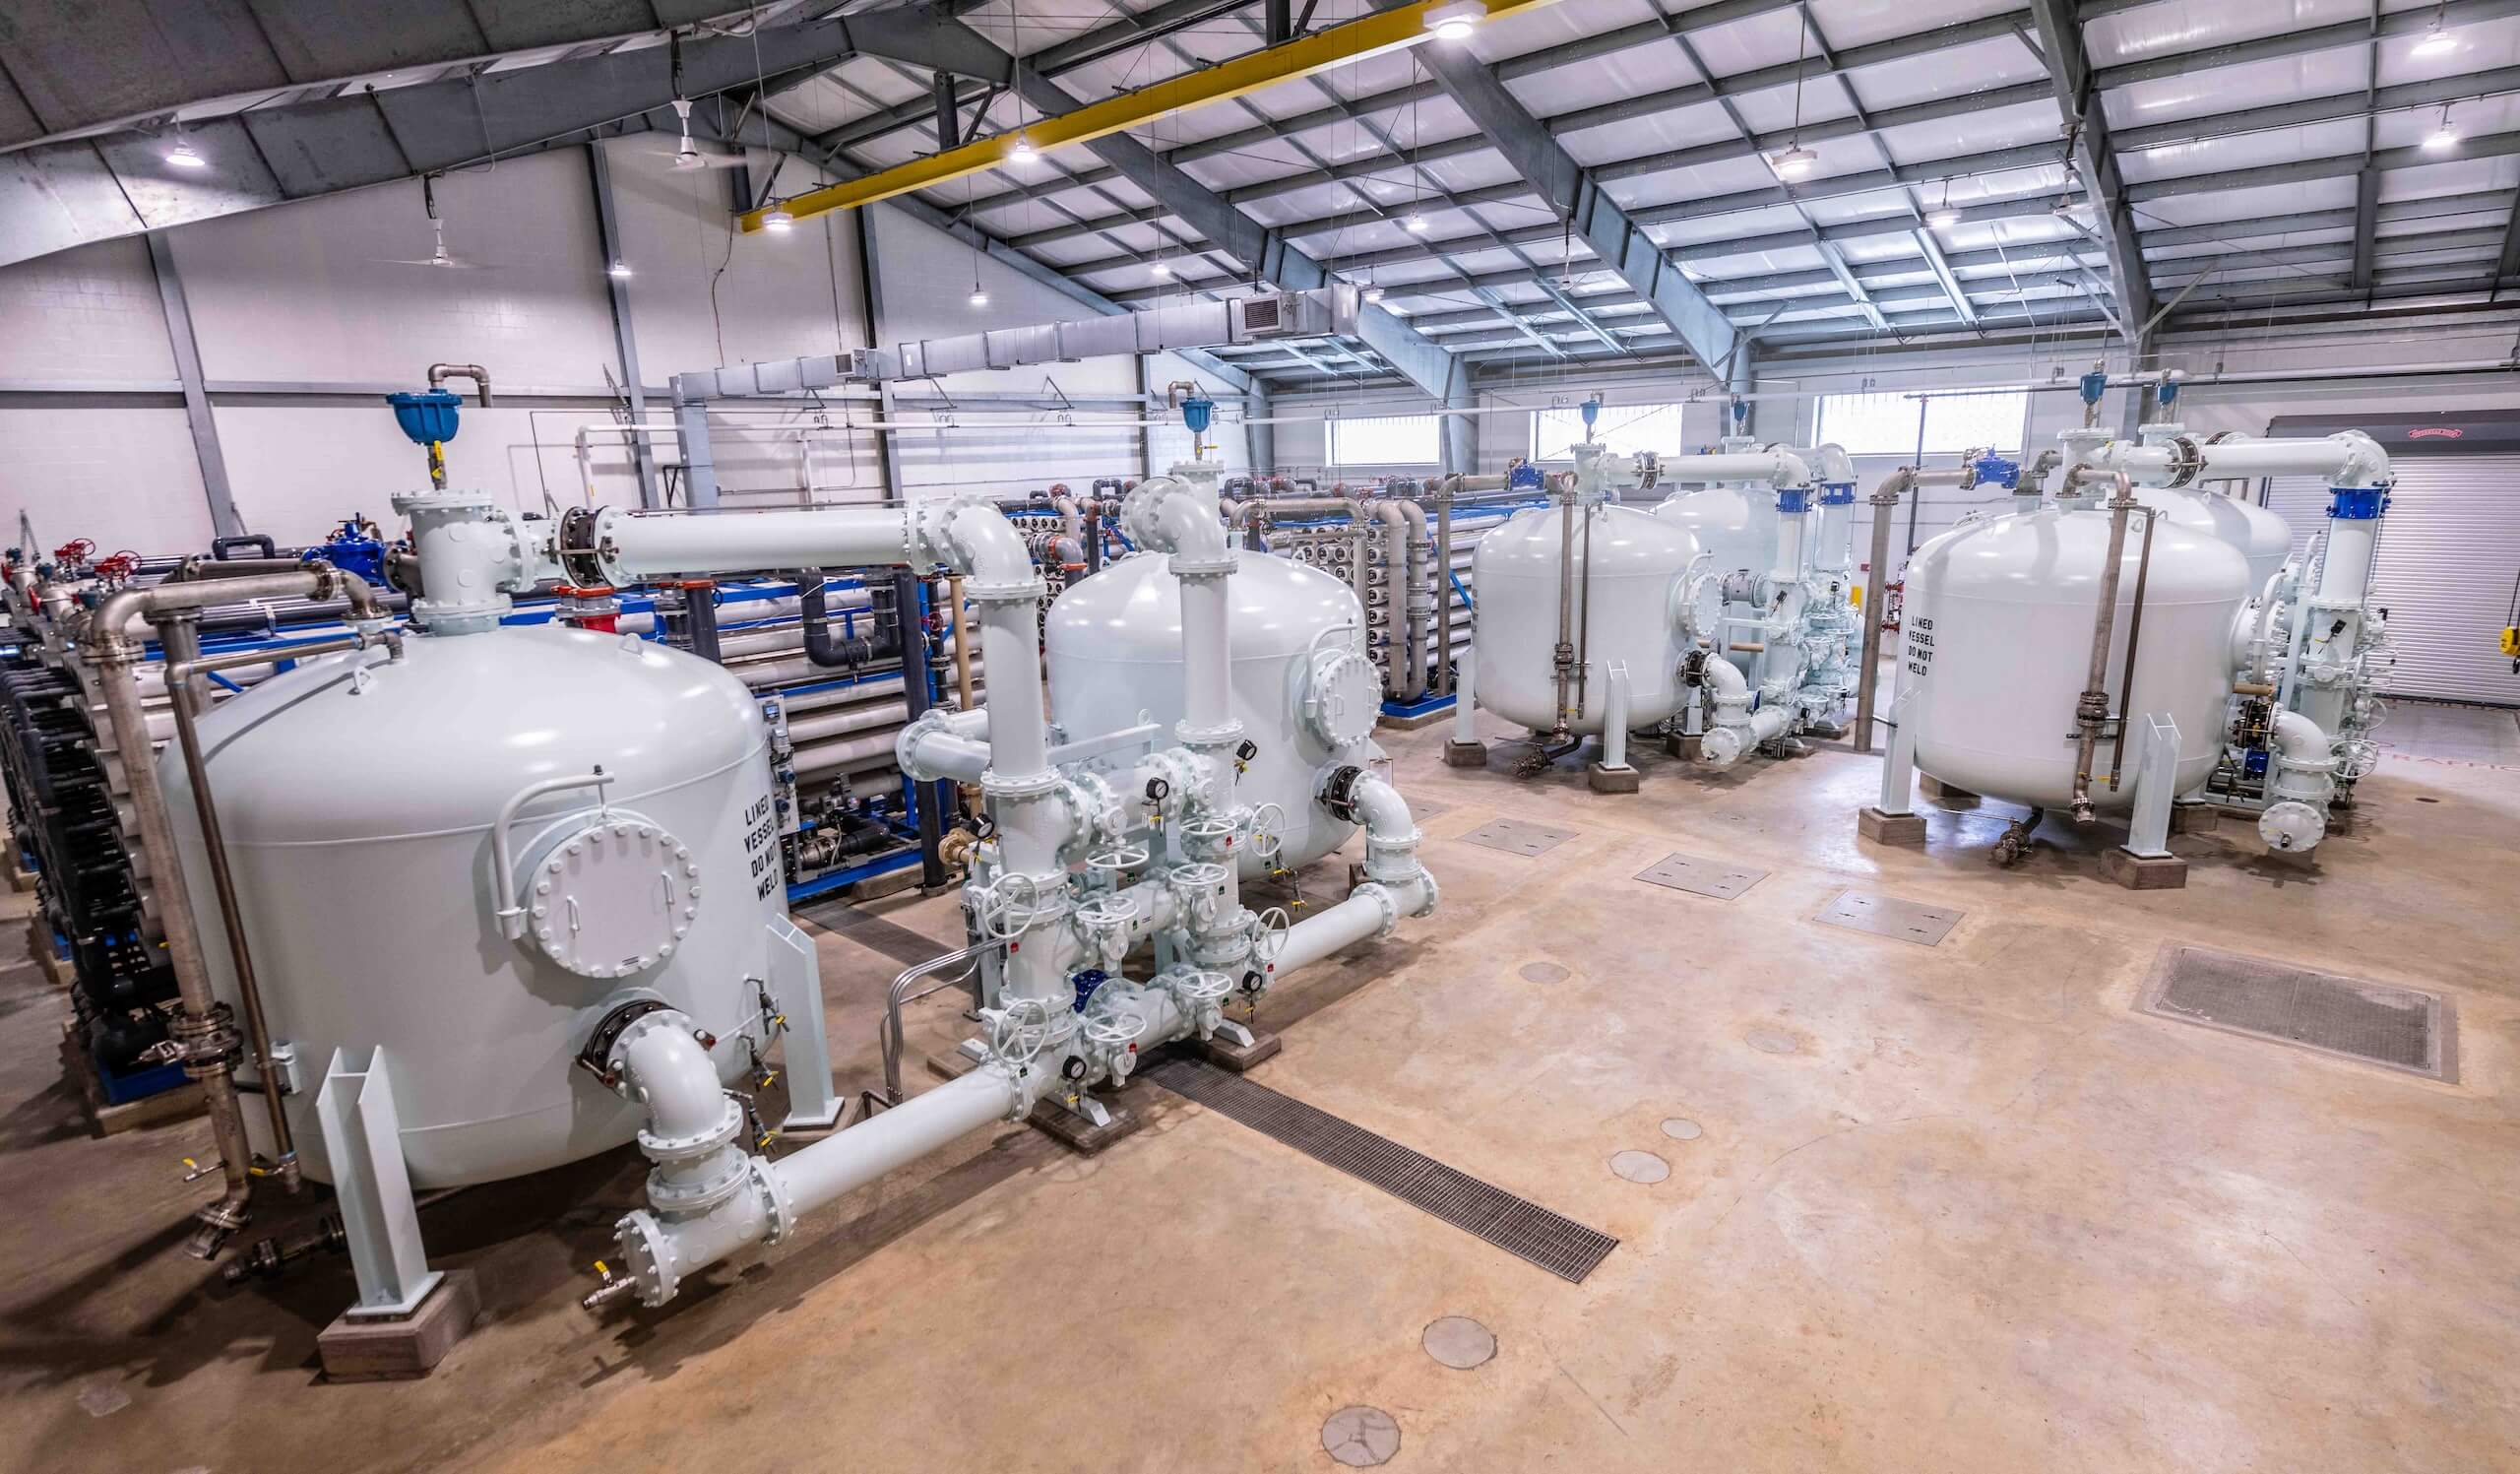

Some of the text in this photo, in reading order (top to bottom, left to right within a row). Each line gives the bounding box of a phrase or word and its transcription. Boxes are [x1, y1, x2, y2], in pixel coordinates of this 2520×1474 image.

[1912, 615, 1933, 630] LINED
[1909, 630, 1934, 646] VESSEL
[1908, 646, 1932, 662] DO NOT
[1908, 661, 1926, 675] WELD
[745, 796, 769, 826] LINED
[744, 817, 774, 854] VESSEL
[751, 841, 777, 878] DO NOT
[757, 868, 779, 901] WELD
